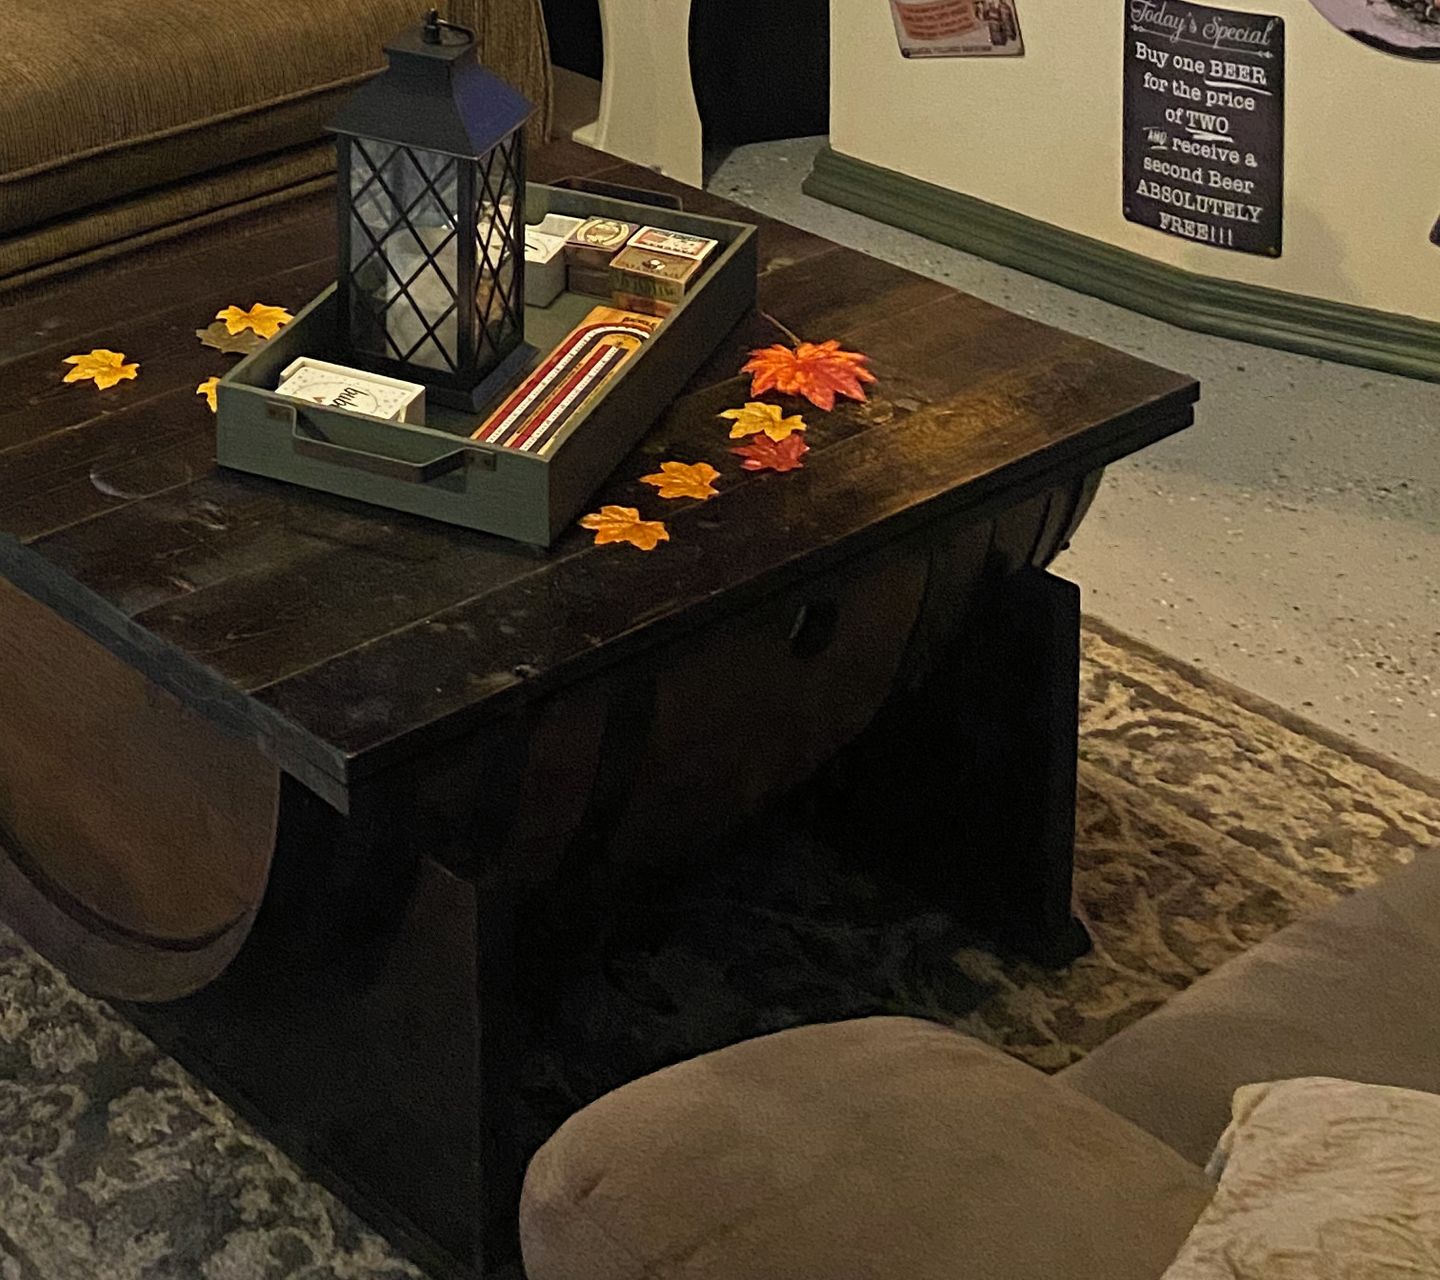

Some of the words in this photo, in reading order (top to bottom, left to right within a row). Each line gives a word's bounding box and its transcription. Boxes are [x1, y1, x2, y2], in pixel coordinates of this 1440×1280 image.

[1202, 15, 1274, 49] Special
[1135, 41, 1169, 69] Buy
[1173, 54, 1205, 74] one
[1209, 59, 1268, 86] BEER
[1143, 71, 1169, 92] for
[1172, 79, 1202, 101] the
[1205, 88, 1255, 111] price
[1165, 107, 1185, 125] of
[1185, 110, 1230, 134] TWO
[1172, 136, 1240, 164] receive
[1244, 152, 1259, 168] a
[1143, 155, 1204, 185] second
[1208, 170, 1255, 195] Beer
[1136, 178, 1263, 224] ABSOLUTELY
[1159, 211, 1234, 246] FREE!!!
